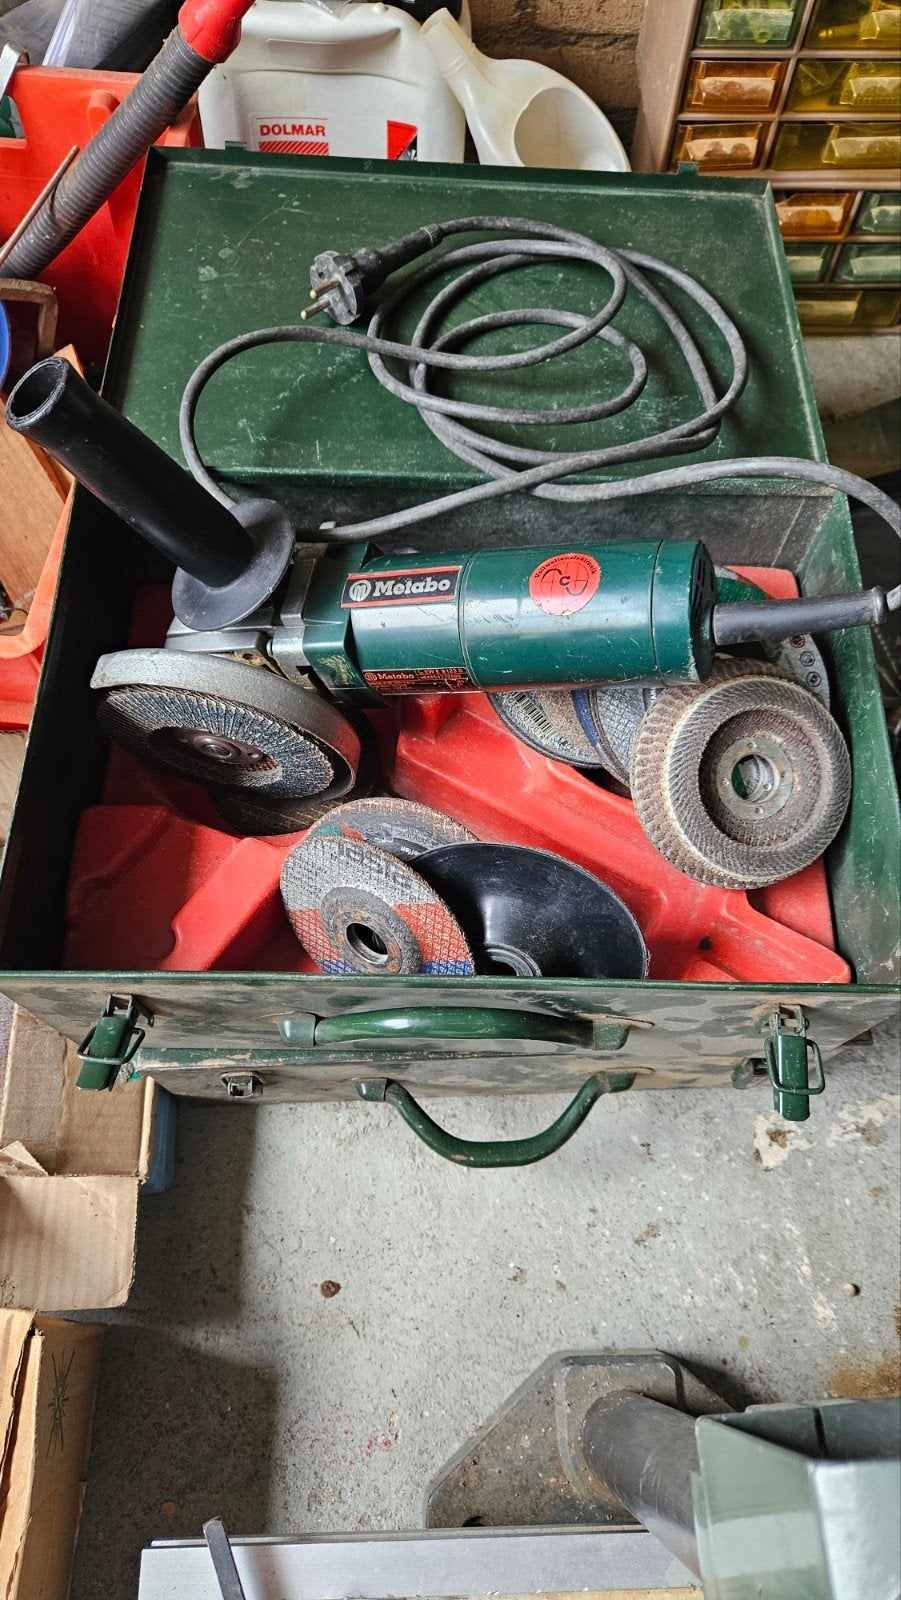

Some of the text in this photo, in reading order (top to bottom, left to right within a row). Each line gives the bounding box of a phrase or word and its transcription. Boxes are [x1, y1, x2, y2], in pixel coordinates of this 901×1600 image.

[260, 123, 326, 136] DOLMAR
[373, 577, 451, 597] Metabo
[377, 672, 415, 680] Metabo
